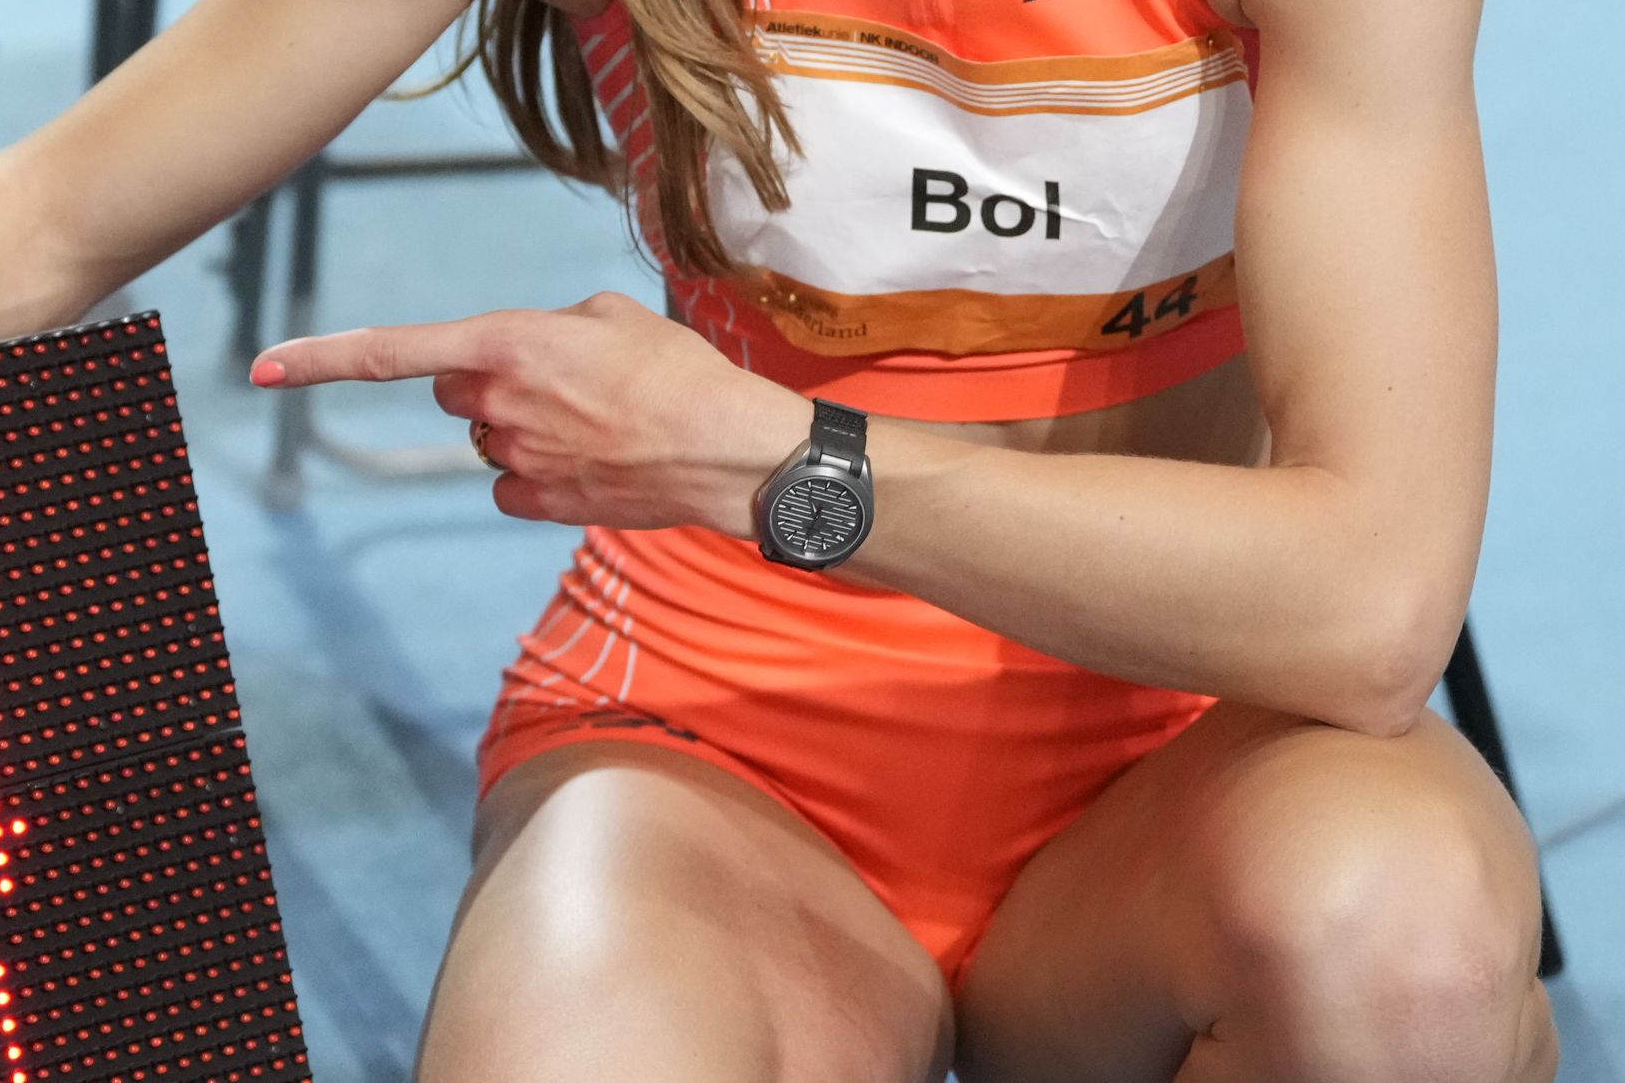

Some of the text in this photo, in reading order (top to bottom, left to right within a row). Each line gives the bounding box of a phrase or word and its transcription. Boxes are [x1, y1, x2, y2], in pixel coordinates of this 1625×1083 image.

[860, 31, 881, 45] NK
[884, 36, 939, 65] INDOOR
[911, 168, 1061, 240] Bol
[1101, 275, 1199, 339] 44
